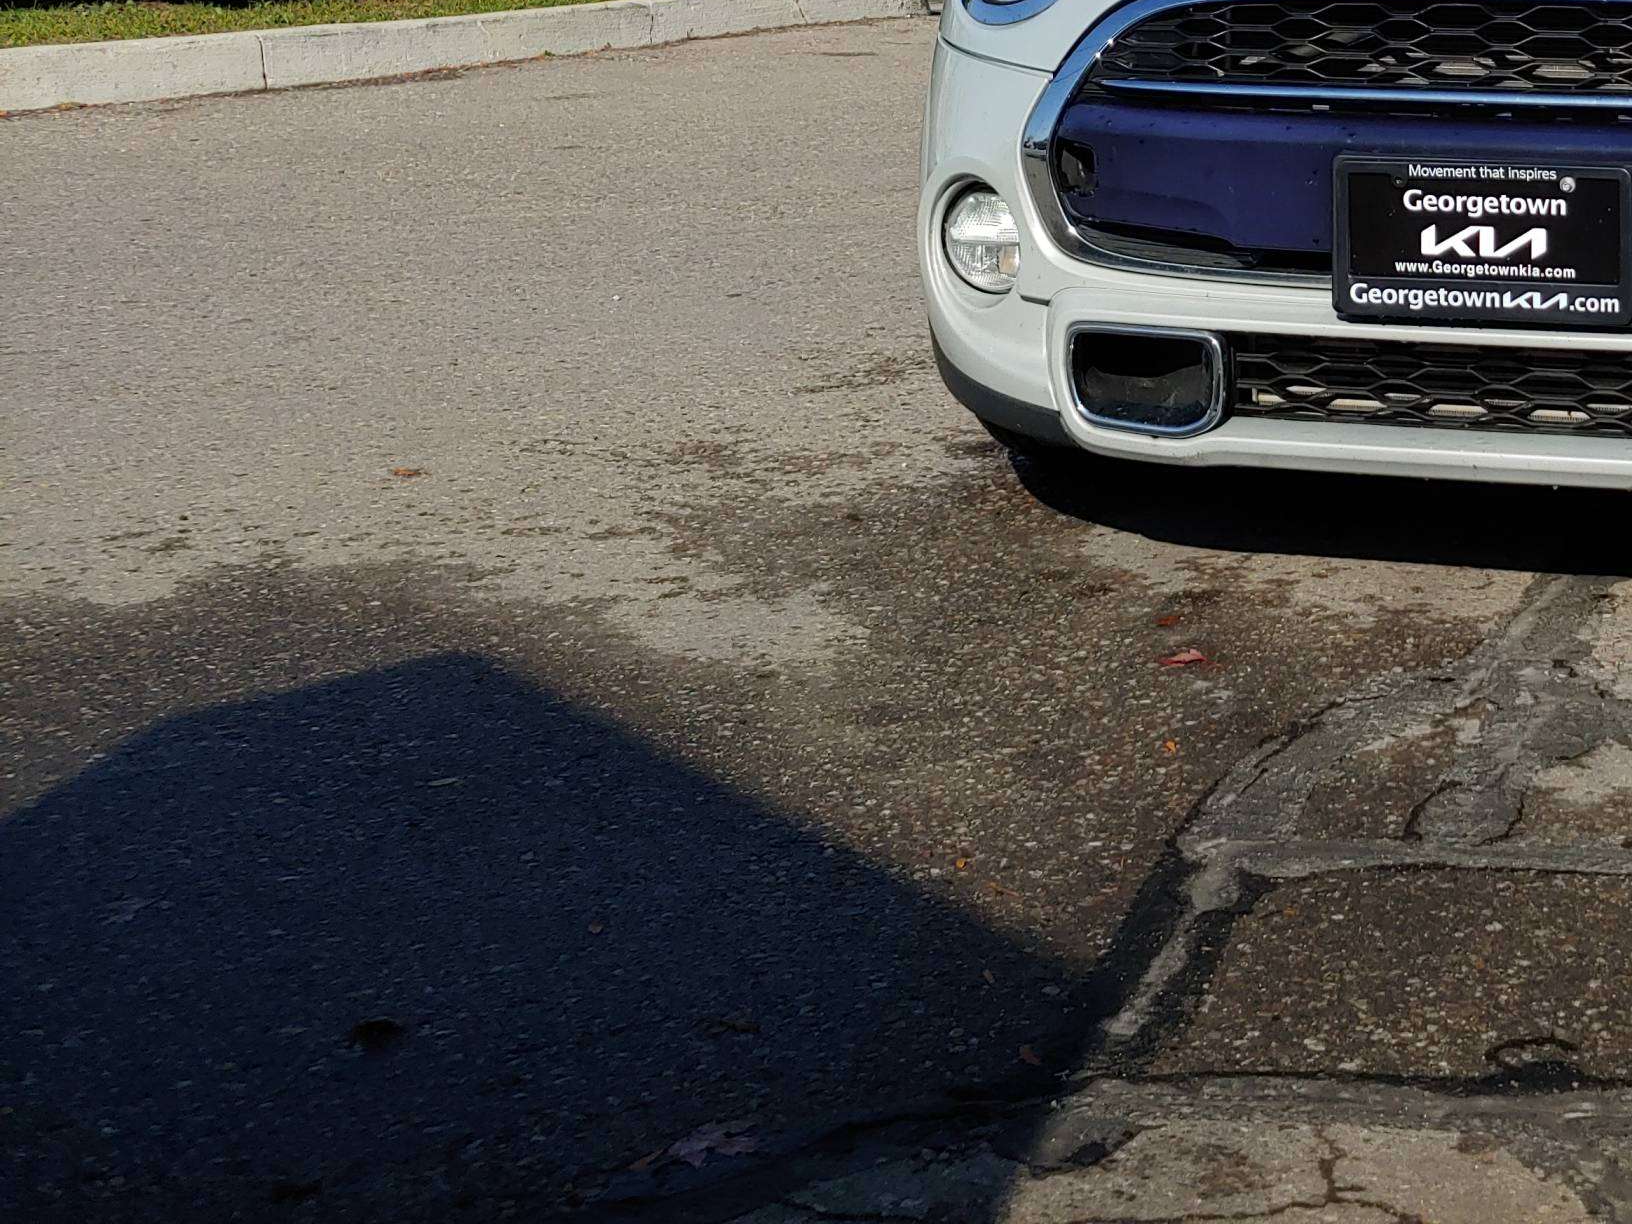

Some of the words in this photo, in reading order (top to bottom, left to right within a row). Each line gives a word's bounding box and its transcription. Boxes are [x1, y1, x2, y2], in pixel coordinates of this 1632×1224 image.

[1408, 164, 1477, 179] Movement
[1479, 166, 1505, 179] that
[1402, 189, 1567, 218] Georgetown
[1420, 224, 1547, 260] KIA
[1394, 260, 1576, 279] www.Georgetownkia.com
